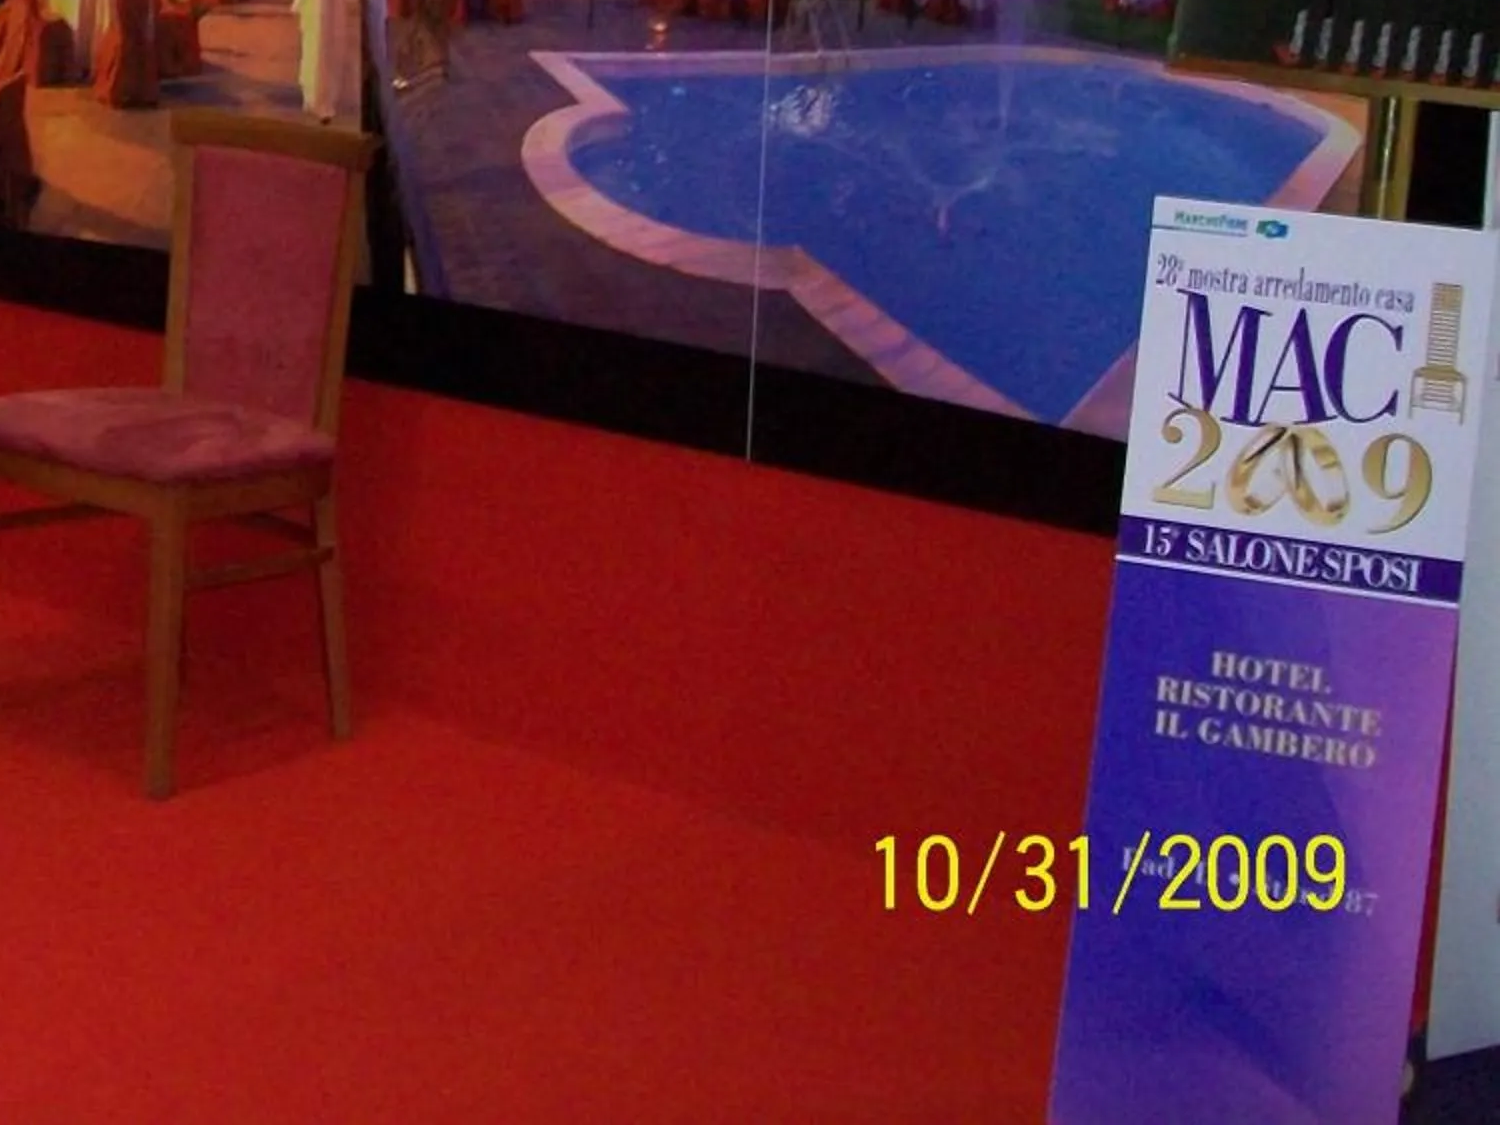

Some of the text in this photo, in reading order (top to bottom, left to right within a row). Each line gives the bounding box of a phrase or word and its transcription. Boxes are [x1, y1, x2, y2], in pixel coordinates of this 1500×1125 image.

[1187, 267, 1248, 295] mostra
[1253, 266, 1372, 307] arredamento
[1374, 287, 1416, 314] casa
[1166, 287, 1405, 429] MAC
[1211, 650, 1332, 695] HOTEL
[1155, 675, 1384, 737] RISTORANTE
[1154, 709, 1377, 770] IL GAMBERO
[1343, 888, 1380, 917] 87
